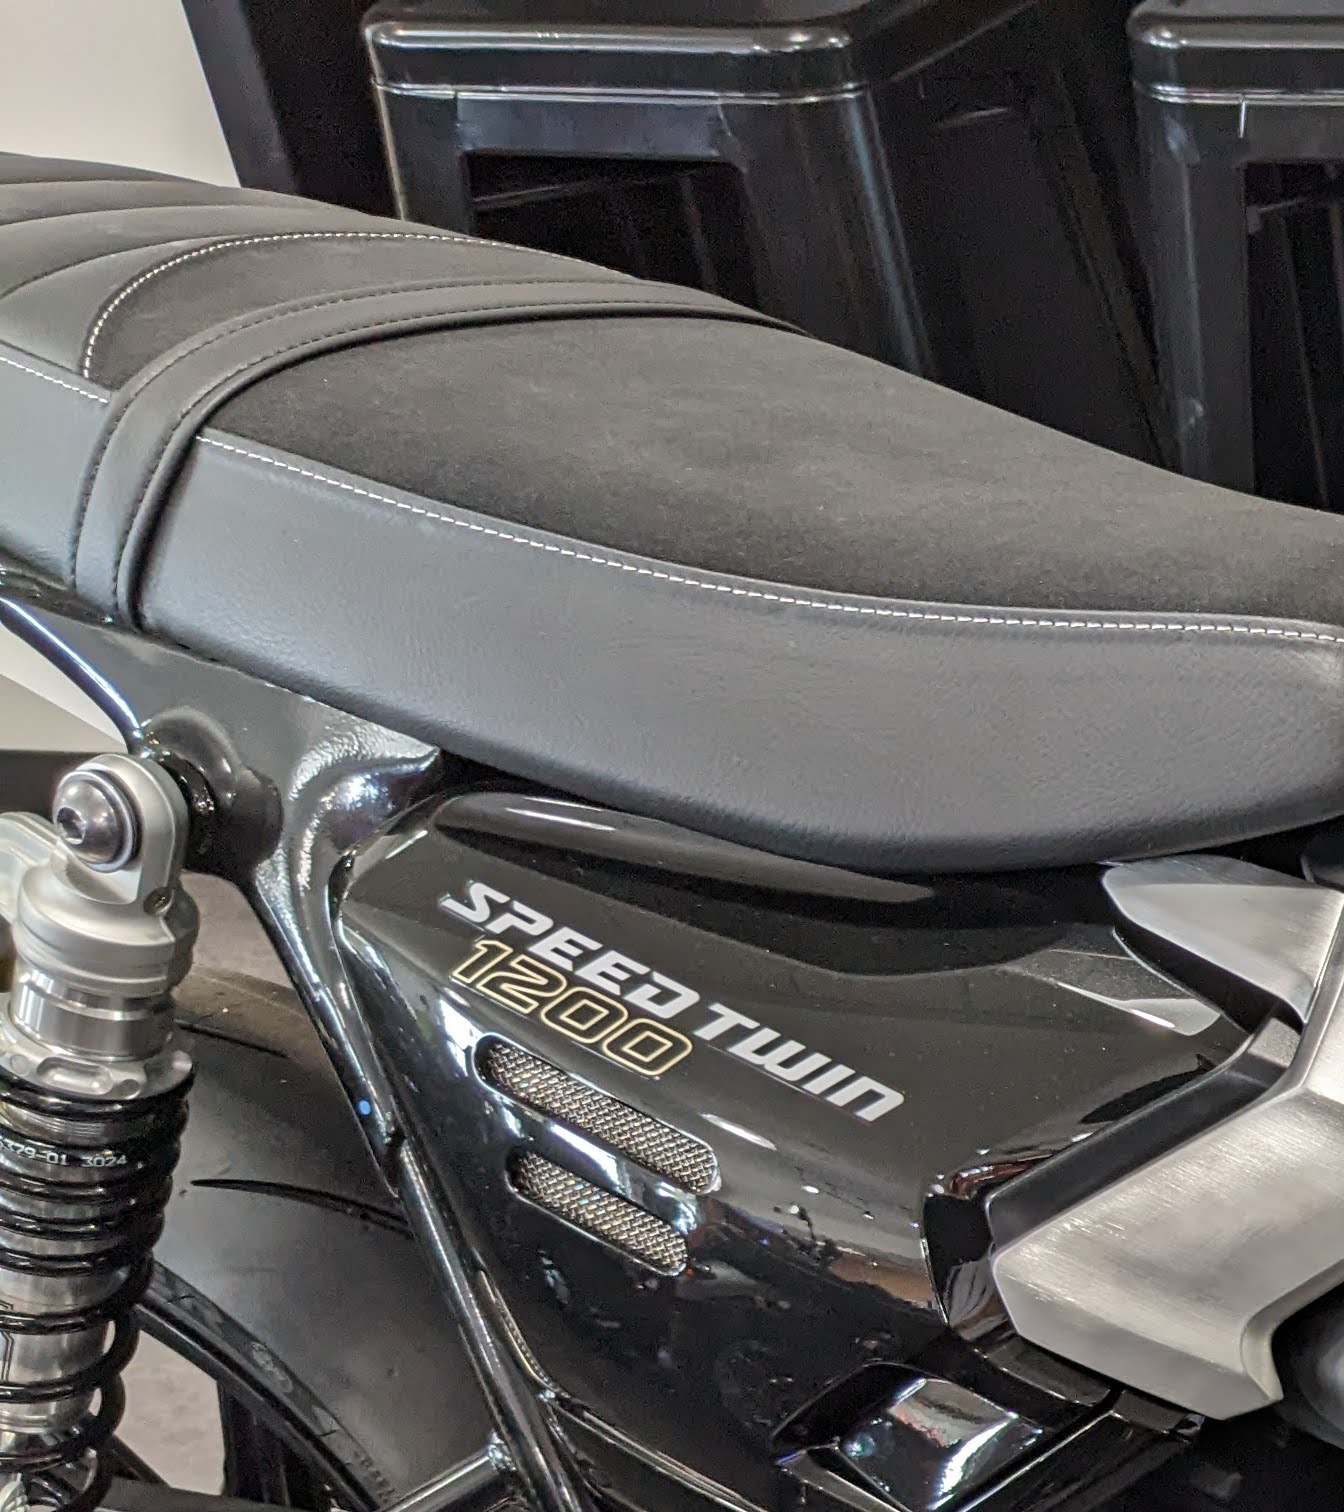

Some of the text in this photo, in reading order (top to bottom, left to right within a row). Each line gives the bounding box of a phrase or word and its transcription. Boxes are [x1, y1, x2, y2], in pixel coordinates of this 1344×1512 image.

[439, 881, 905, 1122] SPEED TWIN
[449, 938, 693, 1076] 1200
